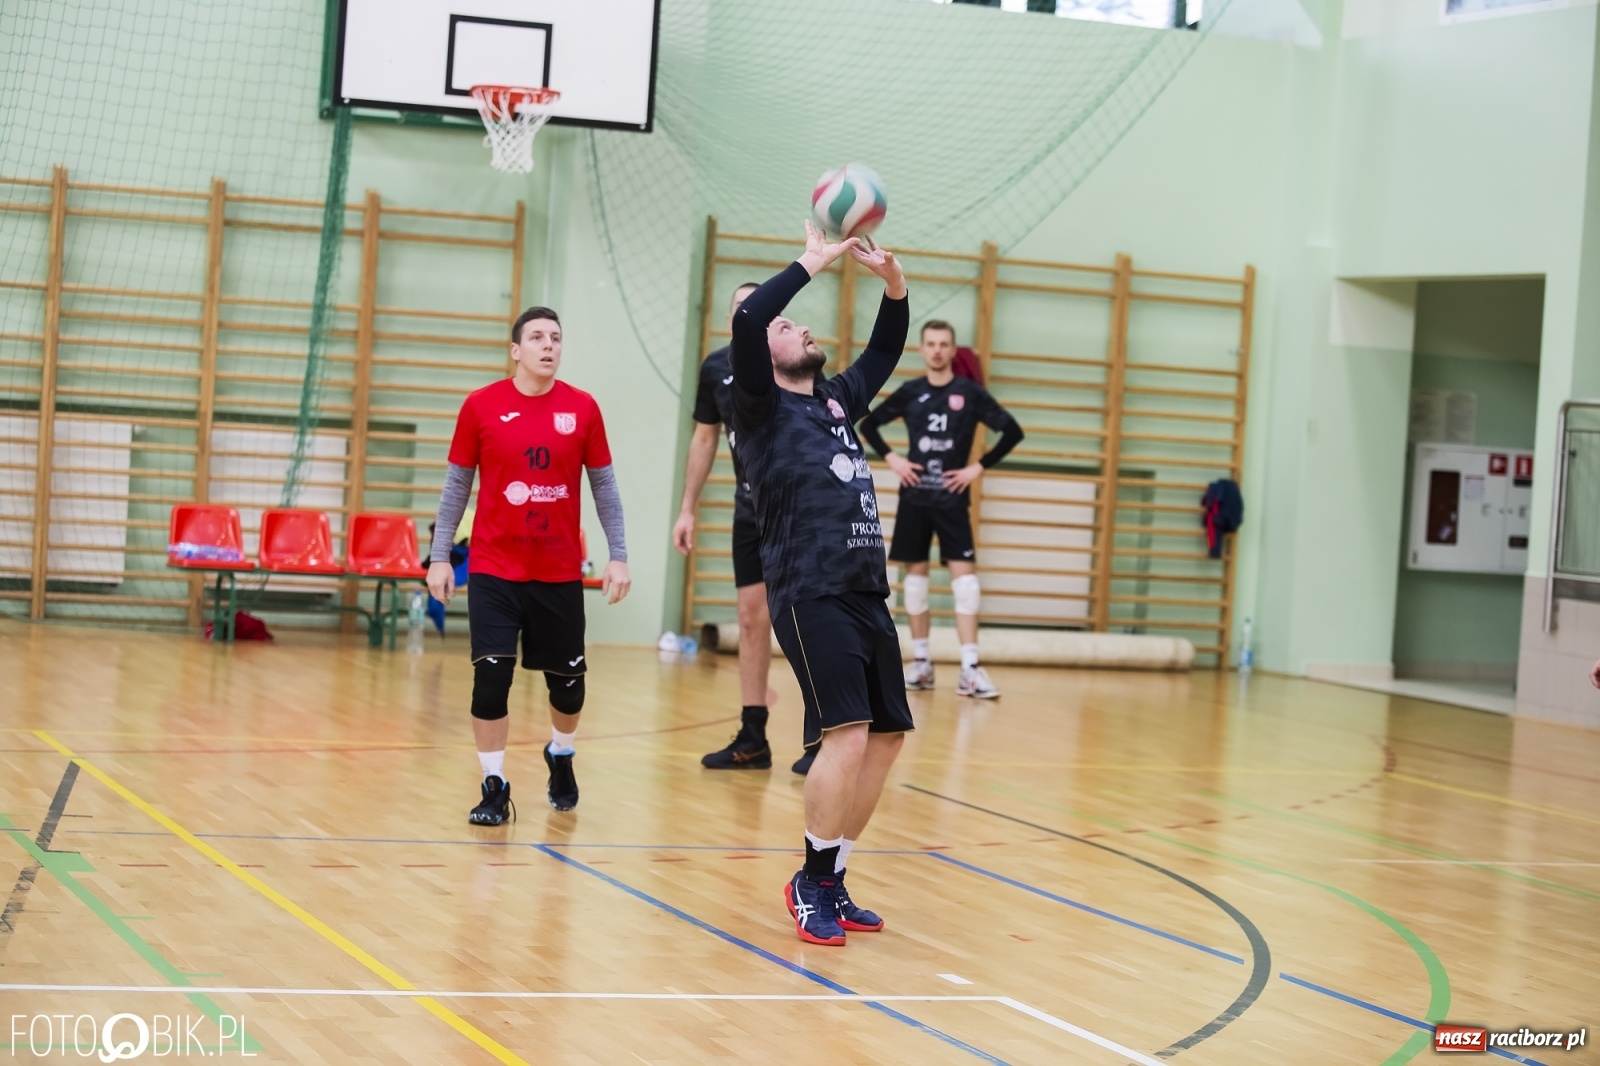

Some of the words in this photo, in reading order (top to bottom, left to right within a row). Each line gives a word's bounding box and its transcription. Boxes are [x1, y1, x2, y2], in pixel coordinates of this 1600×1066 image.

[927, 413, 947, 432] 21
[523, 446, 551, 470] 10
[531, 484, 569, 499] DYMEL
